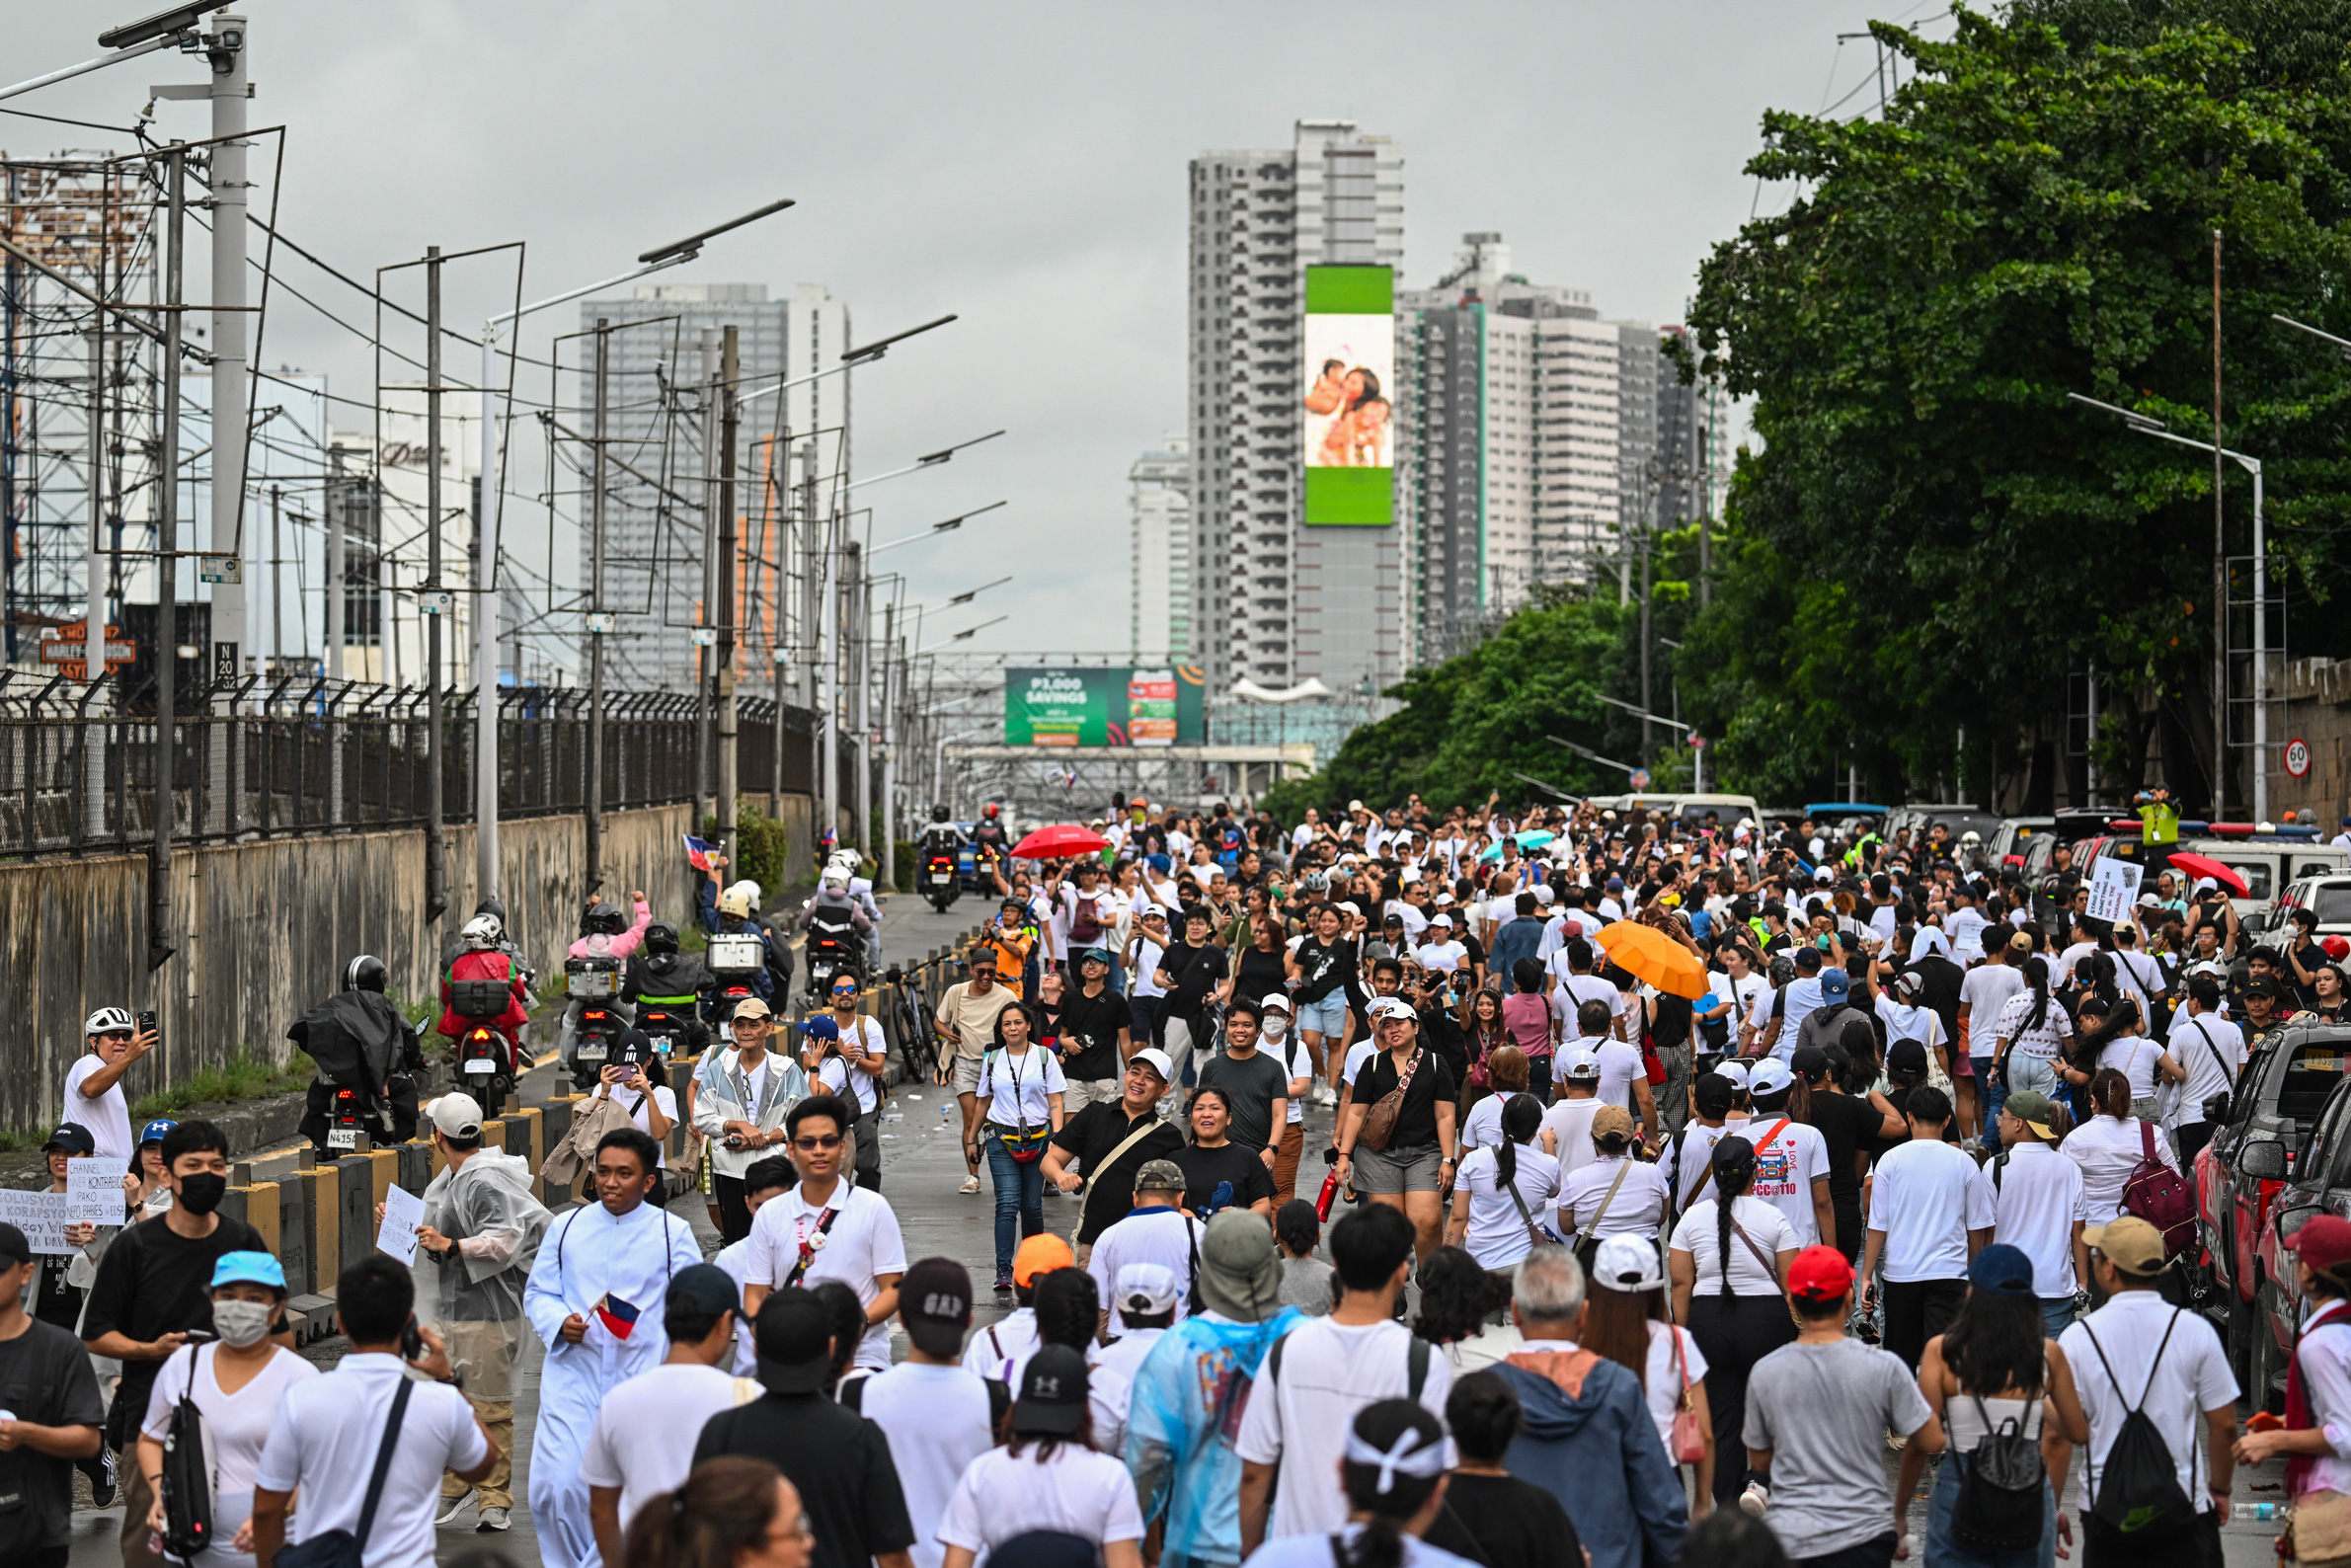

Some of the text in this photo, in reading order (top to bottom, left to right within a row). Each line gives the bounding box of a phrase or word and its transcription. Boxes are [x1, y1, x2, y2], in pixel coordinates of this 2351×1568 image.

[221, 645, 230, 659] N
[219, 661, 232, 674] 20
[1026, 691, 1087, 704] SAVINGS
[2289, 746, 2305, 761] 60
[2098, 871, 2111, 915] SOMETHING OR
[1788, 1150, 1797, 1171] LOVE
[68, 1163, 122, 1175] CHANNEL YOUR
[102, 1193, 115, 1202] ANG
[7, 1205, 66, 1218] KORAPSYO
[66, 1205, 81, 1218] NEPO
[83, 1204, 104, 1218] BABIES
